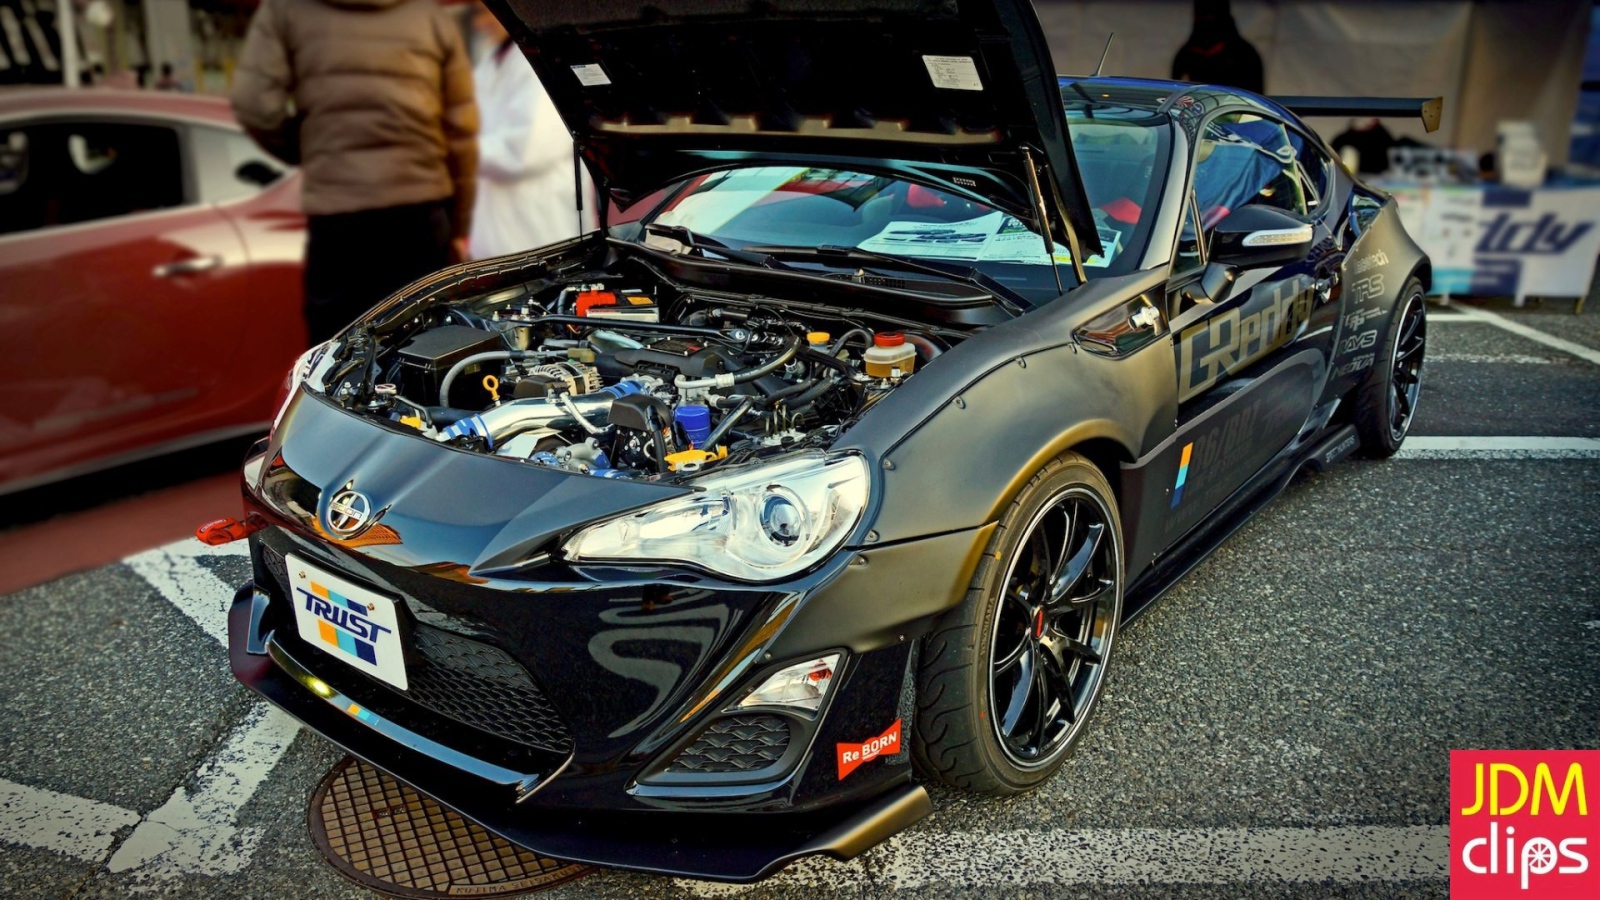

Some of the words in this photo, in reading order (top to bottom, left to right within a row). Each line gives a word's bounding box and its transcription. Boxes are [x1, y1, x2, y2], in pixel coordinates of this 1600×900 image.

[1336, 329, 1378, 357] RAYS
[296, 586, 392, 644] TRUST
[980, 596, 995, 656] YOKOHAMA
[861, 731, 897, 756] BORN
